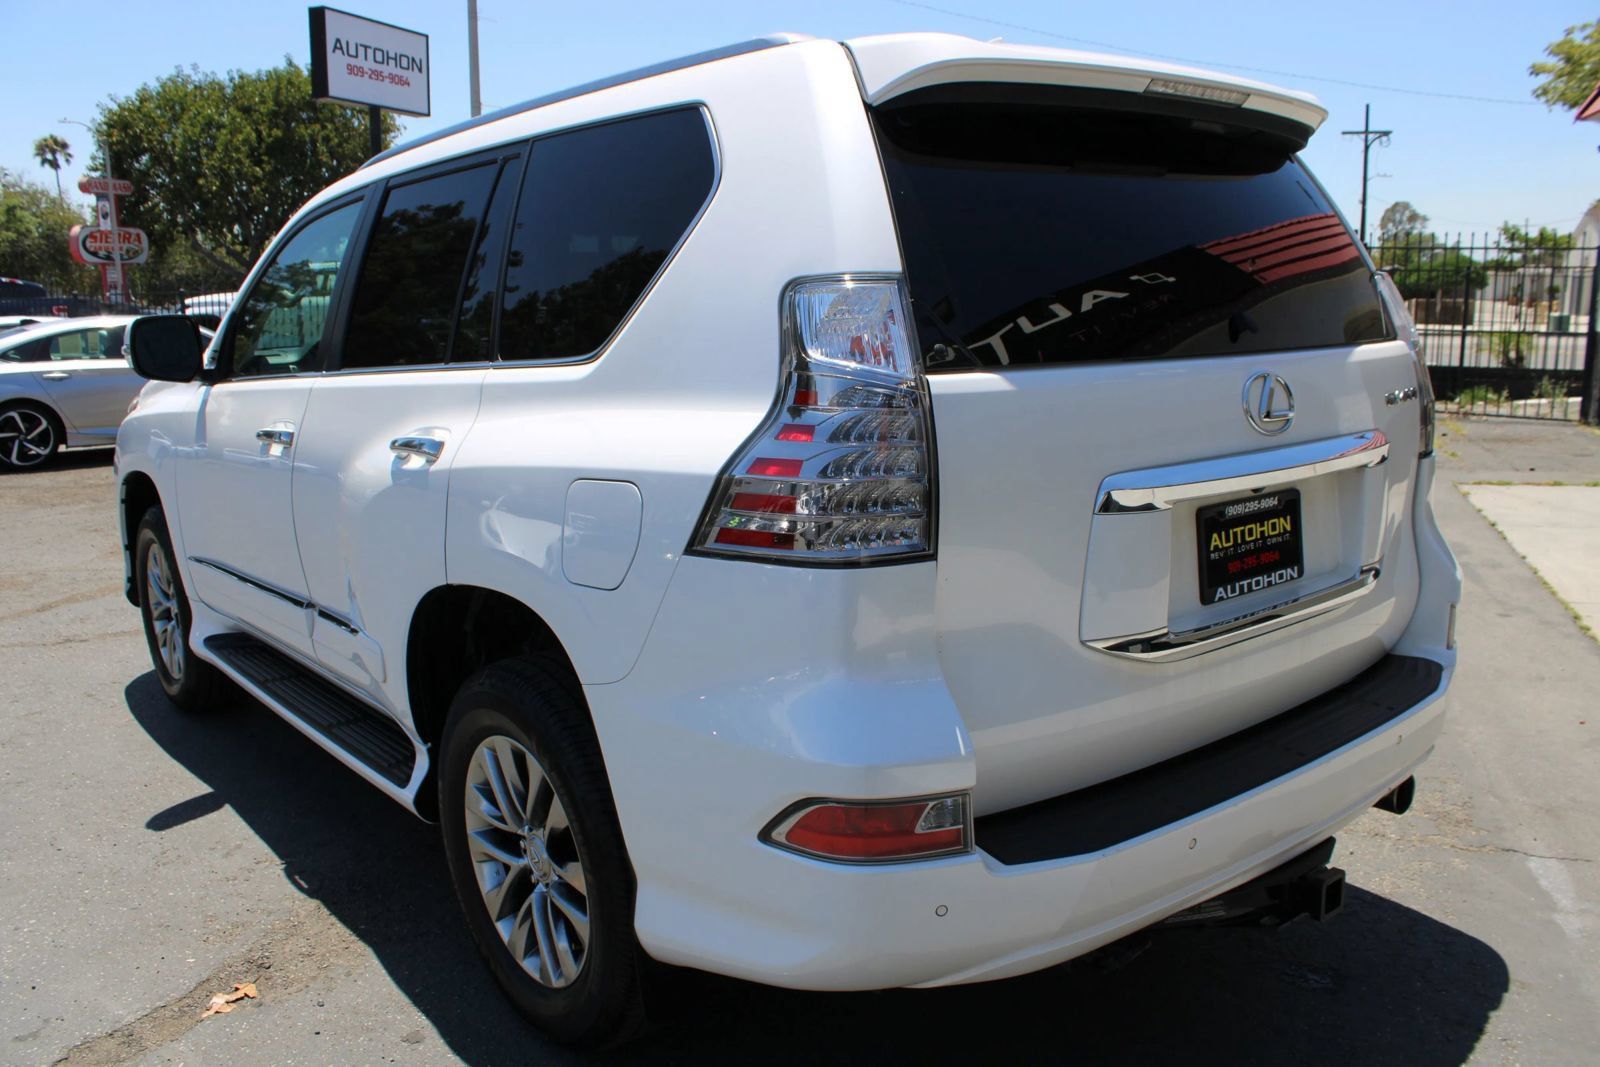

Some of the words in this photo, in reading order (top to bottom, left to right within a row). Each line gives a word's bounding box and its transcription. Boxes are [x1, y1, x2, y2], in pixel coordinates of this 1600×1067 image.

[332, 37, 423, 74] AUTOHON
[346, 63, 410, 88] 909-295-9064
[1225, 495, 1279, 518] (909)295-9064
[1209, 515, 1292, 551] AUTOHON
[1237, 543, 1255, 553] LOVE
[1214, 566, 1299, 602] AUTOHON
